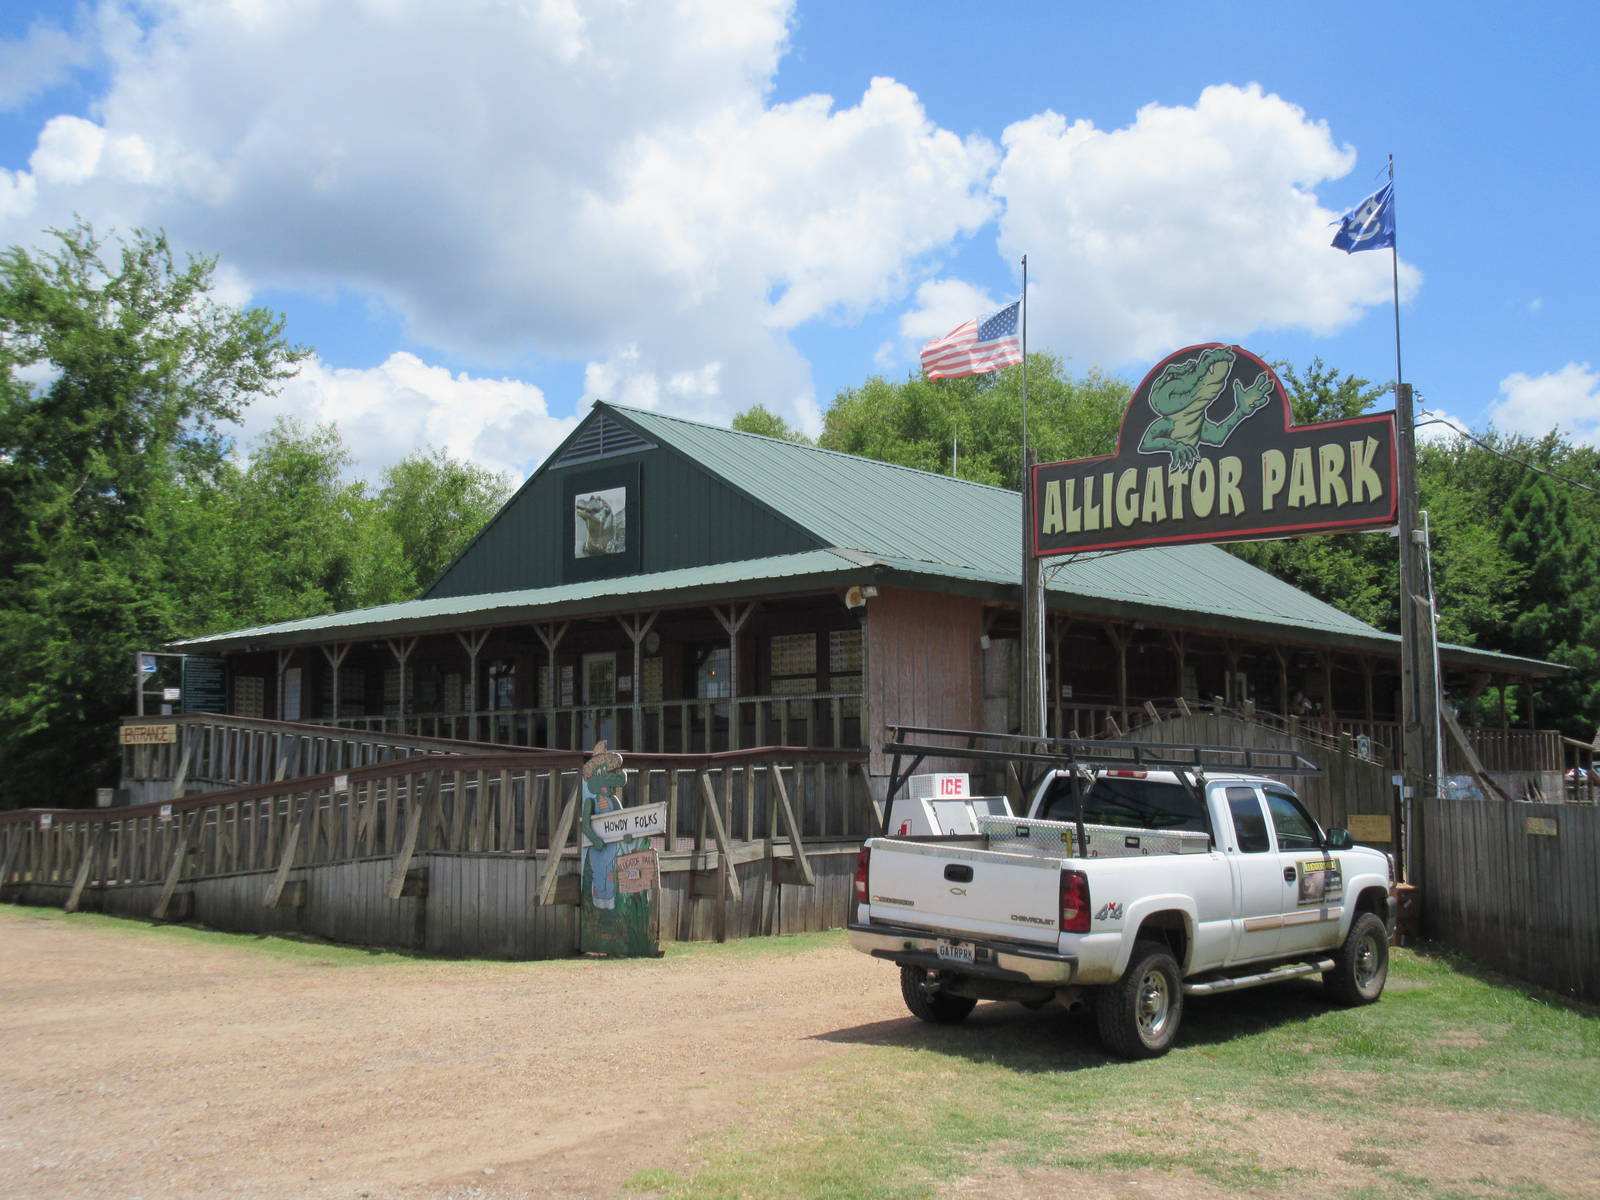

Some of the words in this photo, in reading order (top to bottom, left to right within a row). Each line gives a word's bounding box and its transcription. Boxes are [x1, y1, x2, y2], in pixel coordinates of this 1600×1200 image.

[1041, 455, 1246, 535] ALLIGATOR
[1262, 436, 1384, 511] PARK
[124, 726, 169, 743] ENTRANCE
[941, 778, 963, 796] ICE
[604, 818, 628, 832] HOWDY
[634, 812, 658, 828] FOLKS
[1010, 914, 1056, 925] CHEVROLET
[939, 945, 974, 961] GATRPRK
